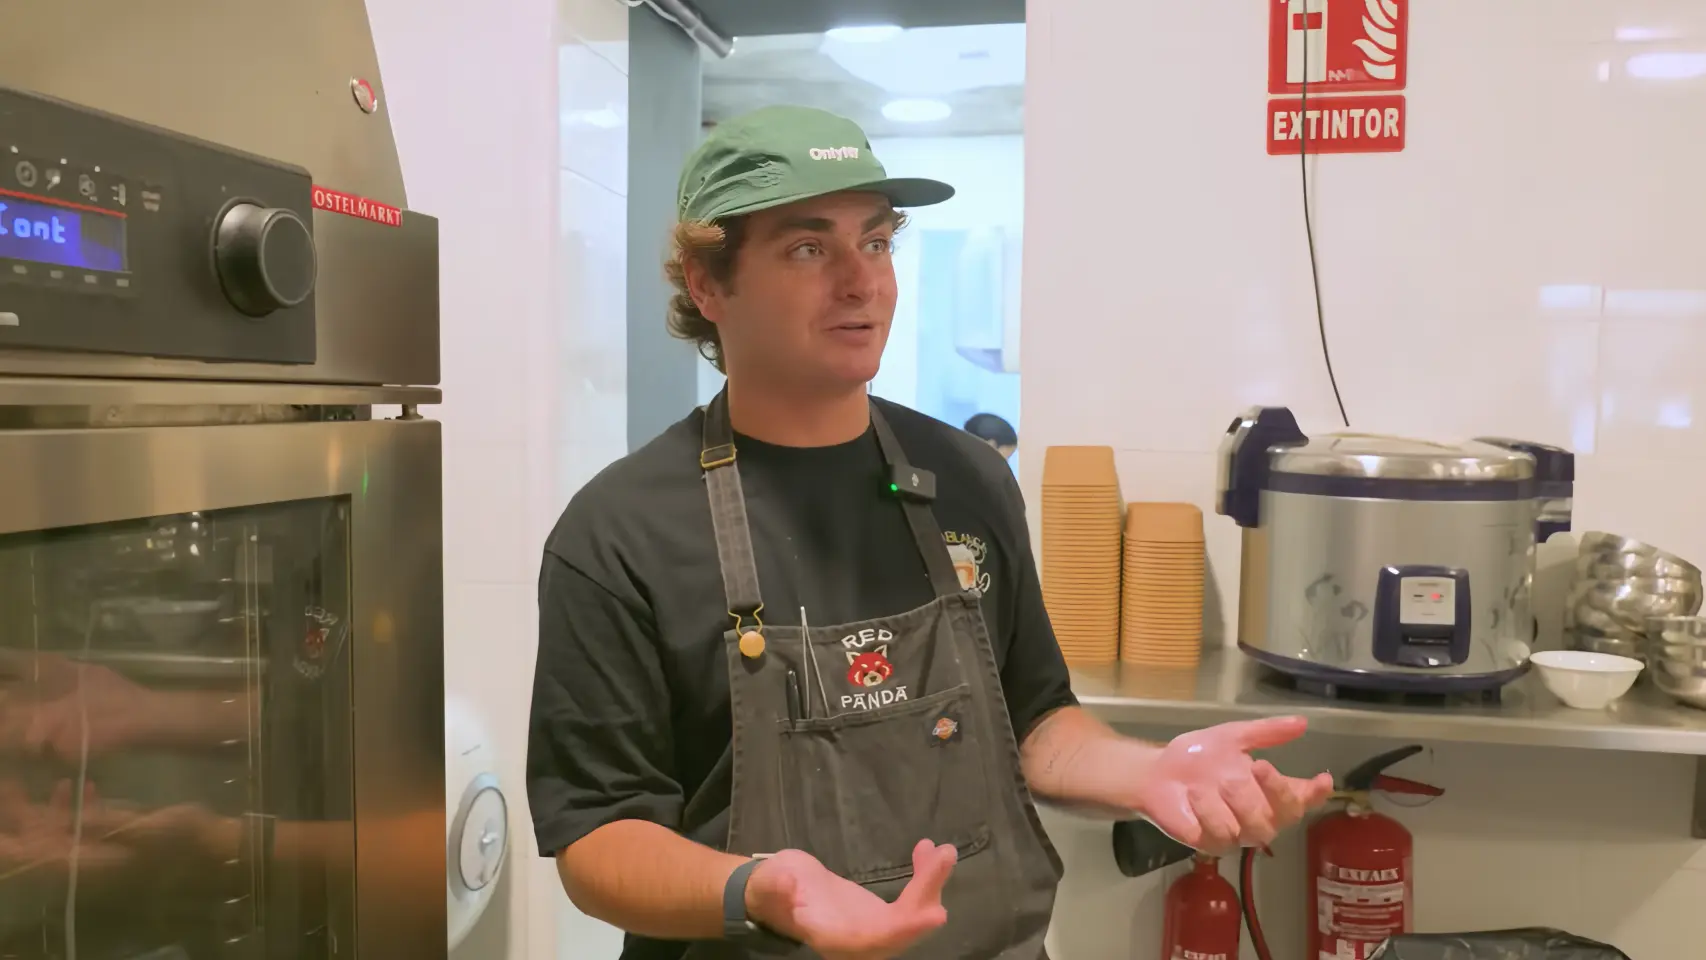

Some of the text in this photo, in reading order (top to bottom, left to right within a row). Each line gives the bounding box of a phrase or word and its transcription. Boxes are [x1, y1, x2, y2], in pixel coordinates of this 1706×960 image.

[1273, 107, 1399, 141] EXTINTOR
[314, 189, 402, 227] OSTELMARKT
[841, 628, 893, 649] RED
[840, 685, 908, 710] PANDA
